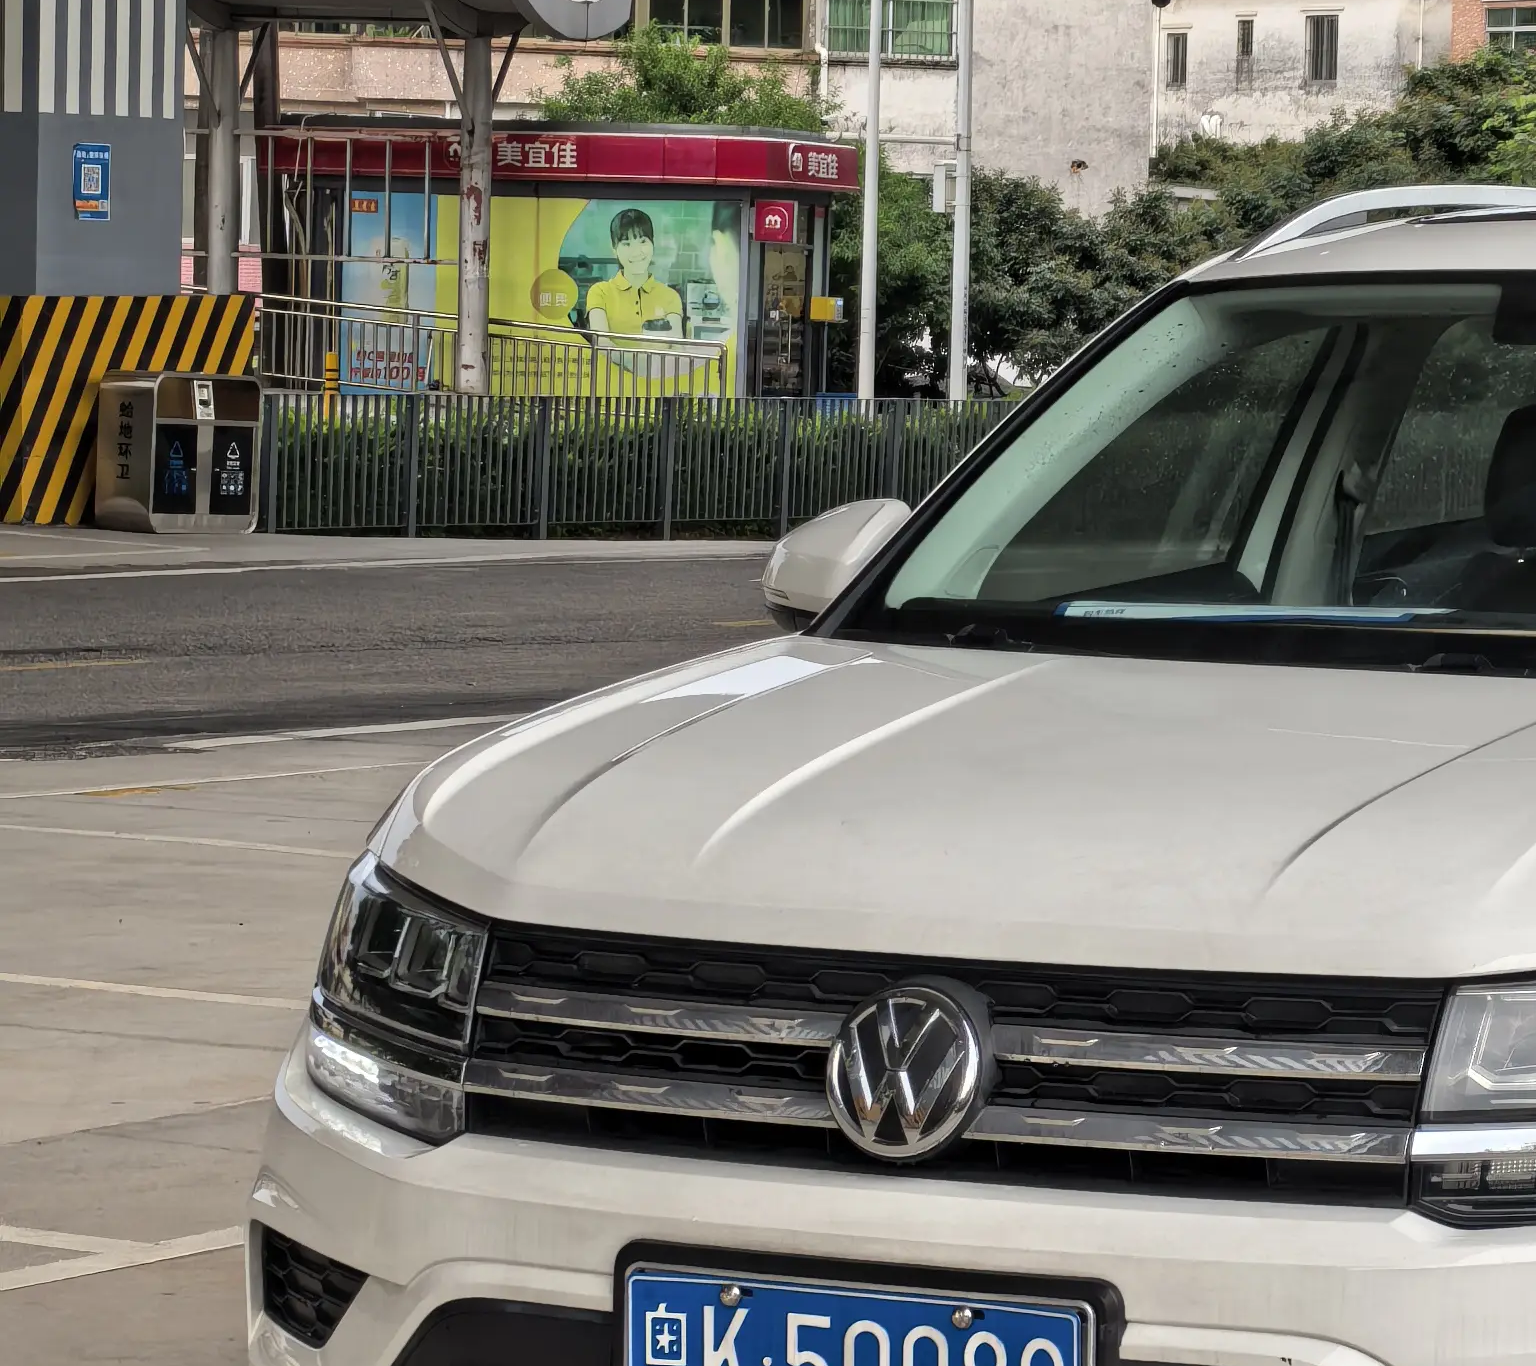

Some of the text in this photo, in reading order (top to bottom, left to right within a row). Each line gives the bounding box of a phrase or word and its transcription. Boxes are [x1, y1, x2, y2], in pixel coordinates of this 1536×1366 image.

[496, 141, 578, 168] 美宜佳
[807, 151, 839, 179] 美宜佳
